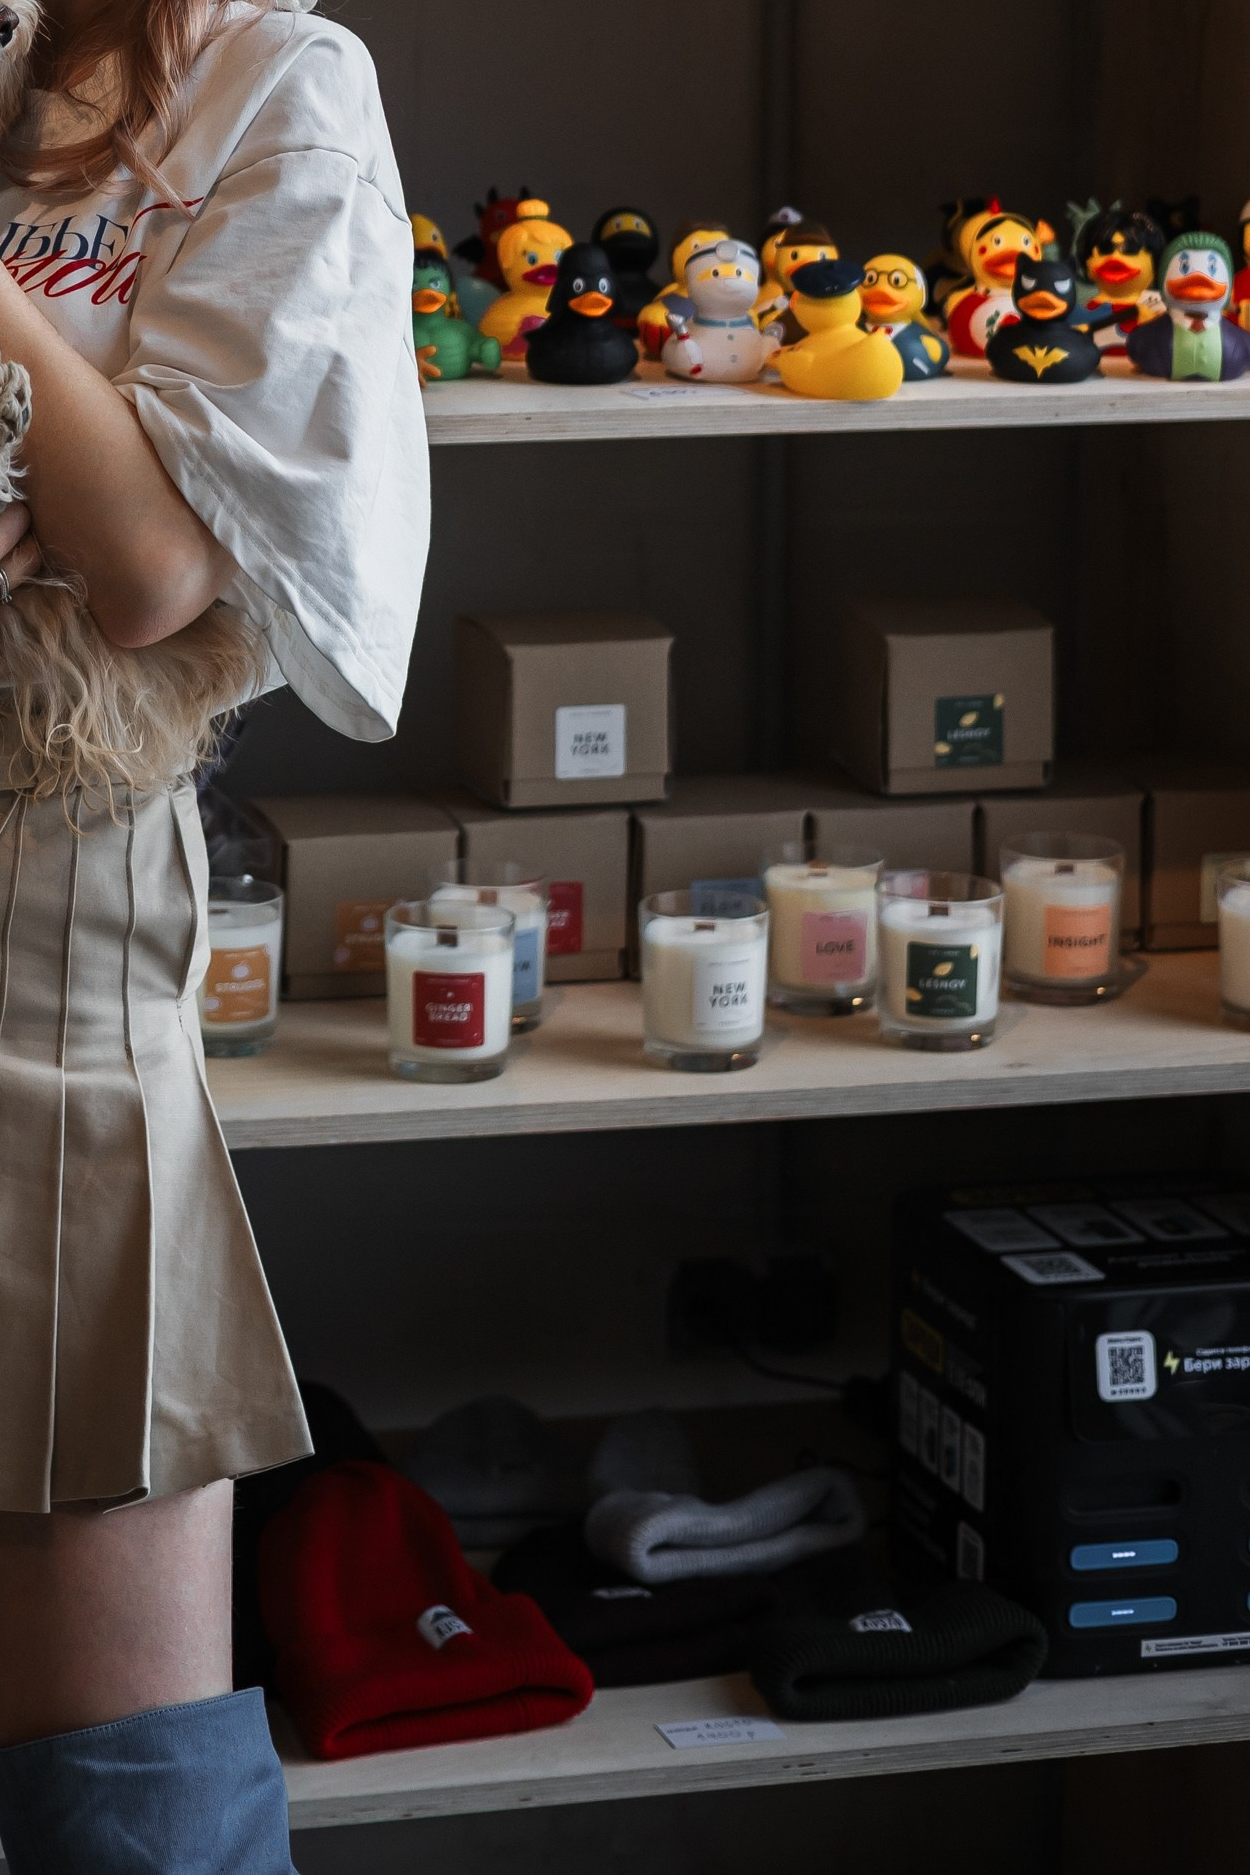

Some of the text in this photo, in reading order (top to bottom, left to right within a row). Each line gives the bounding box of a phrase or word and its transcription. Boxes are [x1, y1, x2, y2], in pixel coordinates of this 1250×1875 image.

[573, 732, 607, 745] NEW
[570, 744, 610, 756] YORK
[816, 939, 854, 955] LOVE
[1048, 933, 1105, 948] INSIGHT
[713, 982, 746, 995] NEW
[709, 992, 748, 1008] YORK
[426, 1003, 473, 1013] GINGER
[428, 1012, 471, 1022] BREAD
[1226, 1358, 1250, 1370] зар
